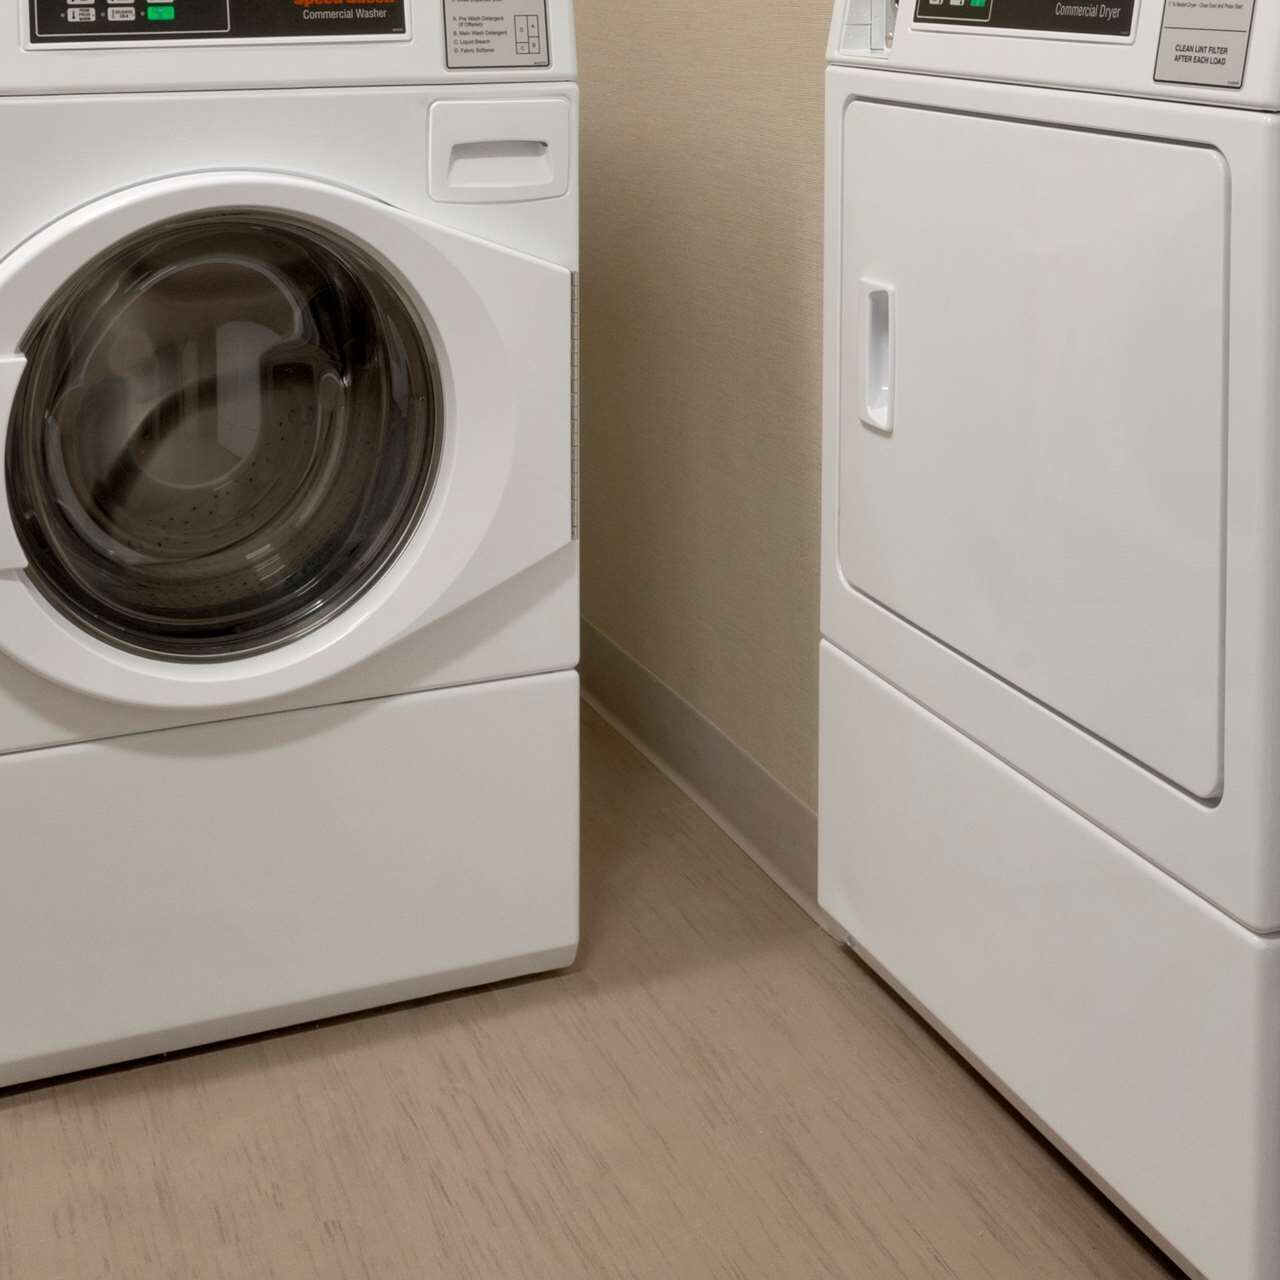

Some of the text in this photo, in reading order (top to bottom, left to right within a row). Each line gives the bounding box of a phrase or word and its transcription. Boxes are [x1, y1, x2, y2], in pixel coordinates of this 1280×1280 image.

[303, 8, 387, 19] Commercial Washer
[1055, 2, 1121, 21] Commercial Dryer
[1176, 44, 1194, 52] CLEAN
[1208, 47, 1228, 55] FILTER
[1174, 55, 1226, 65] AFTER EACH LOAD
